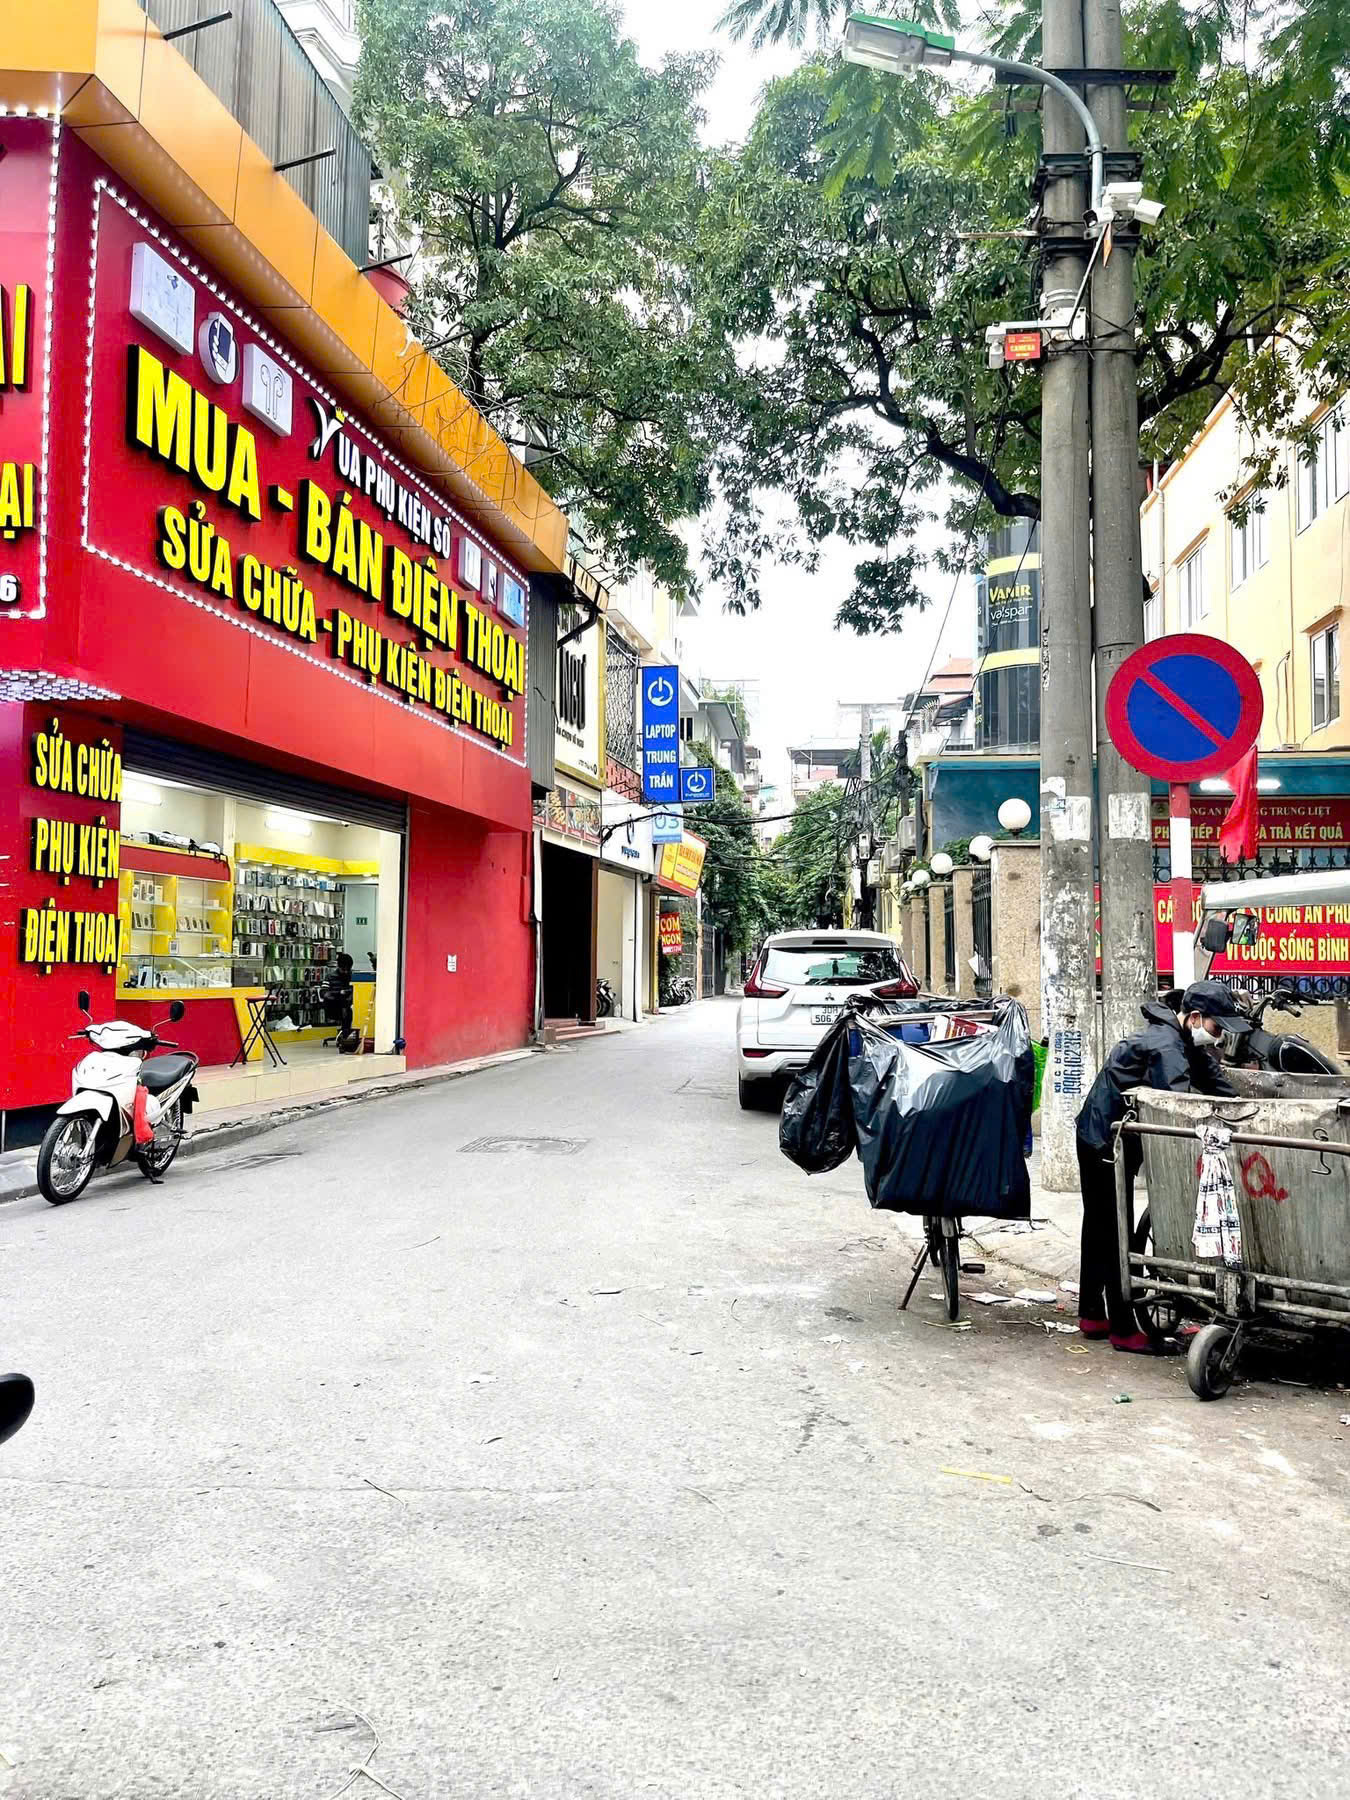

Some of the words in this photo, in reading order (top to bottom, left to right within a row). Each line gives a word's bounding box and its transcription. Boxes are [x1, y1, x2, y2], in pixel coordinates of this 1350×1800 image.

[365, 455, 396, 521] PHỤ
[398, 485, 432, 545] KIỆN
[433, 516, 452, 560] SỐ
[135, 347, 261, 521] MUA
[306, 480, 384, 602] BÁN
[392, 546, 458, 651] ĐIỆN
[465, 601, 525, 700] THOẠI
[162, 500, 234, 599] SỬA
[243, 553, 318, 643] CHỮA
[337, 609, 382, 686] PHỤ
[386, 638, 431, 705] KIỆN
[434, 668, 473, 729] ĐIỆN
[474, 691, 513, 752] THOẠI
[645, 724, 676, 739] LAPTOP
[35, 717, 73, 793] SỬA
[76, 738, 122, 803] CHỮA
[645, 750, 677, 764] TRUNG
[1208, 807, 1222, 816] AN
[1269, 807, 1306, 816] TRUNG
[1308, 807, 1332, 818] LIỆT
[1269, 822, 1292, 840] TRẢ
[1294, 822, 1317, 840] KẾT
[1319, 822, 1344, 841] QUẢ
[35, 817, 75, 886] PHỤ
[78, 815, 121, 889] KIỆN
[1303, 906, 1323, 924] AN
[24, 897, 71, 974] ĐIỆN
[74, 911, 124, 974] THOẠI
[661, 933, 682, 945] NGON
[1279, 928, 1315, 962] SỐNG
[1317, 932, 1349, 962] BÌNH
